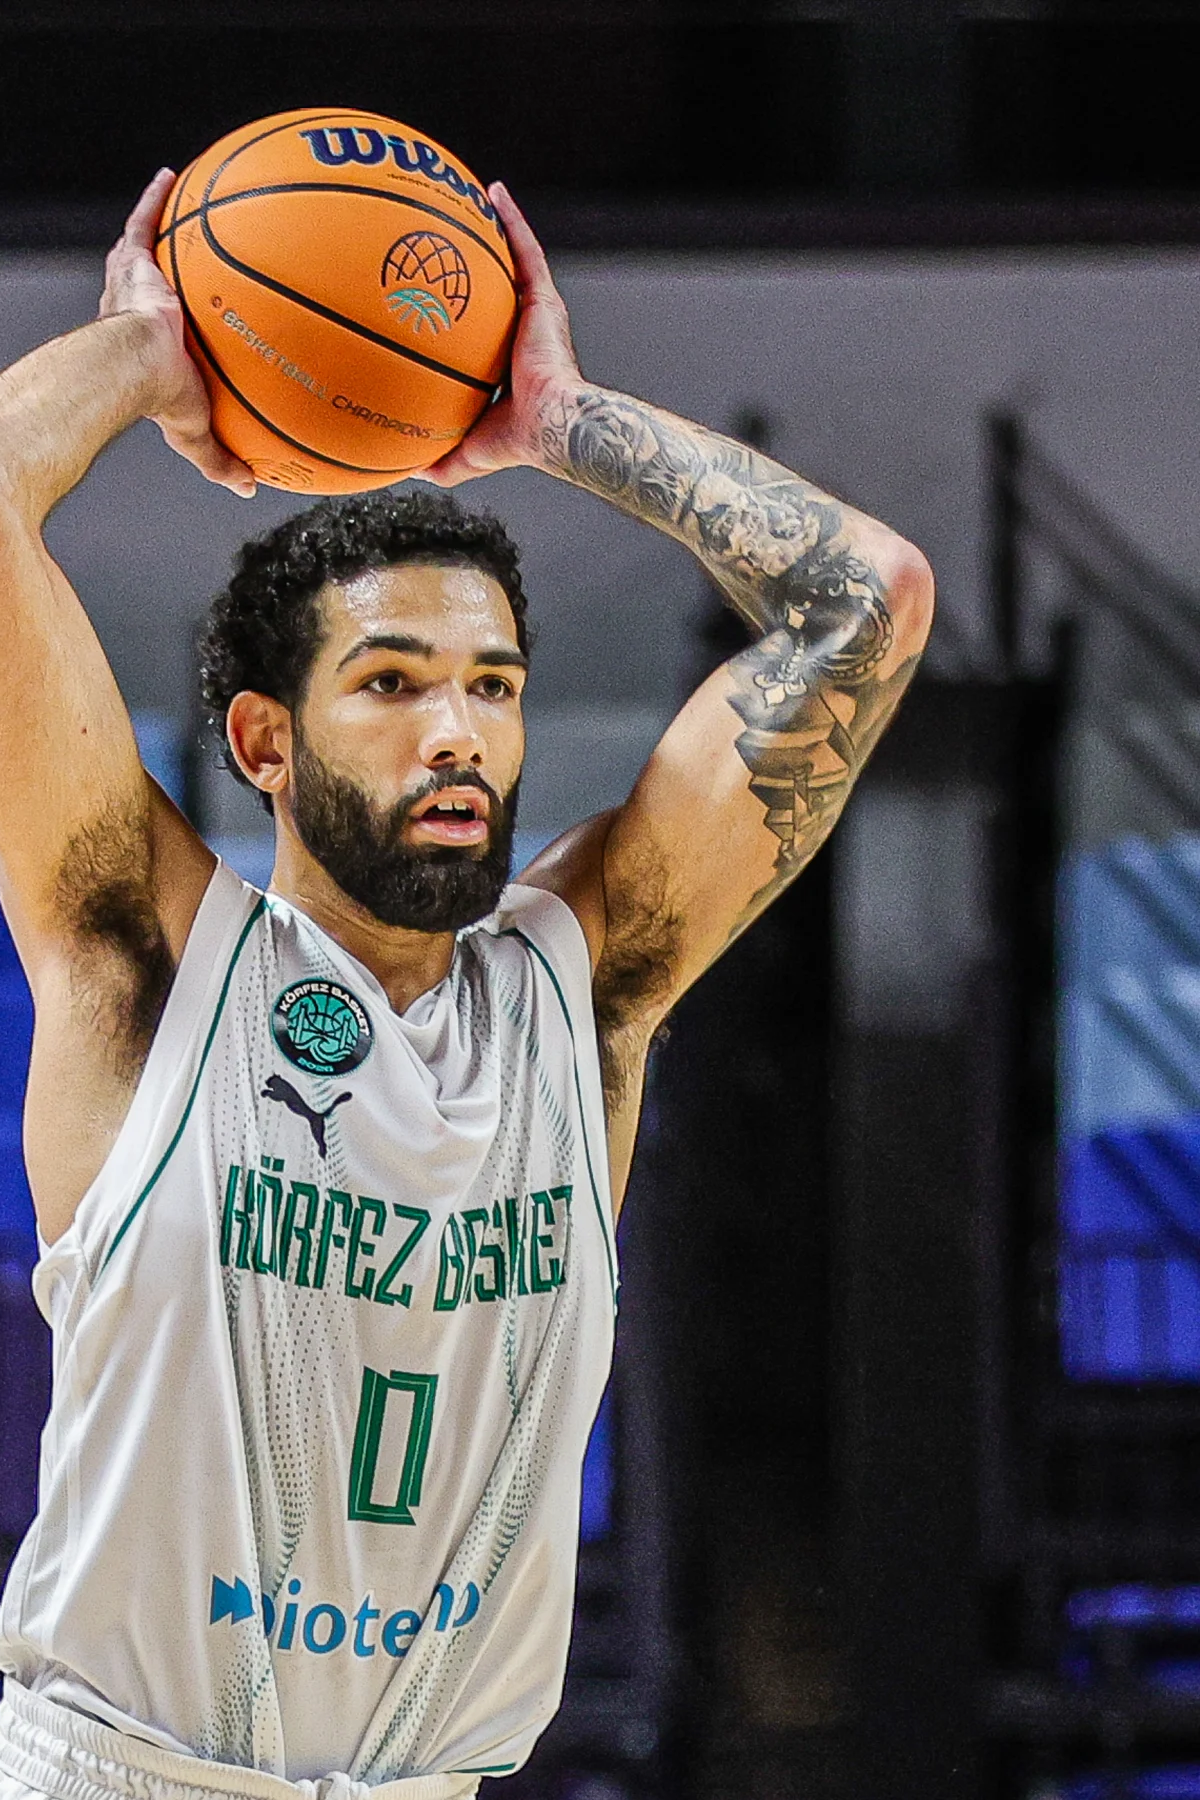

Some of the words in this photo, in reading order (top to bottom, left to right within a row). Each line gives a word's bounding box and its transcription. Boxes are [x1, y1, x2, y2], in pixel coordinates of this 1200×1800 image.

[300, 127, 506, 241] Wilso
[280, 983, 330, 1012] KÖRFEZ
[331, 986, 370, 1037] BASKET
[220, 1155, 431, 1309] KÖRFEZ
[347, 1365, 439, 1525] 0
